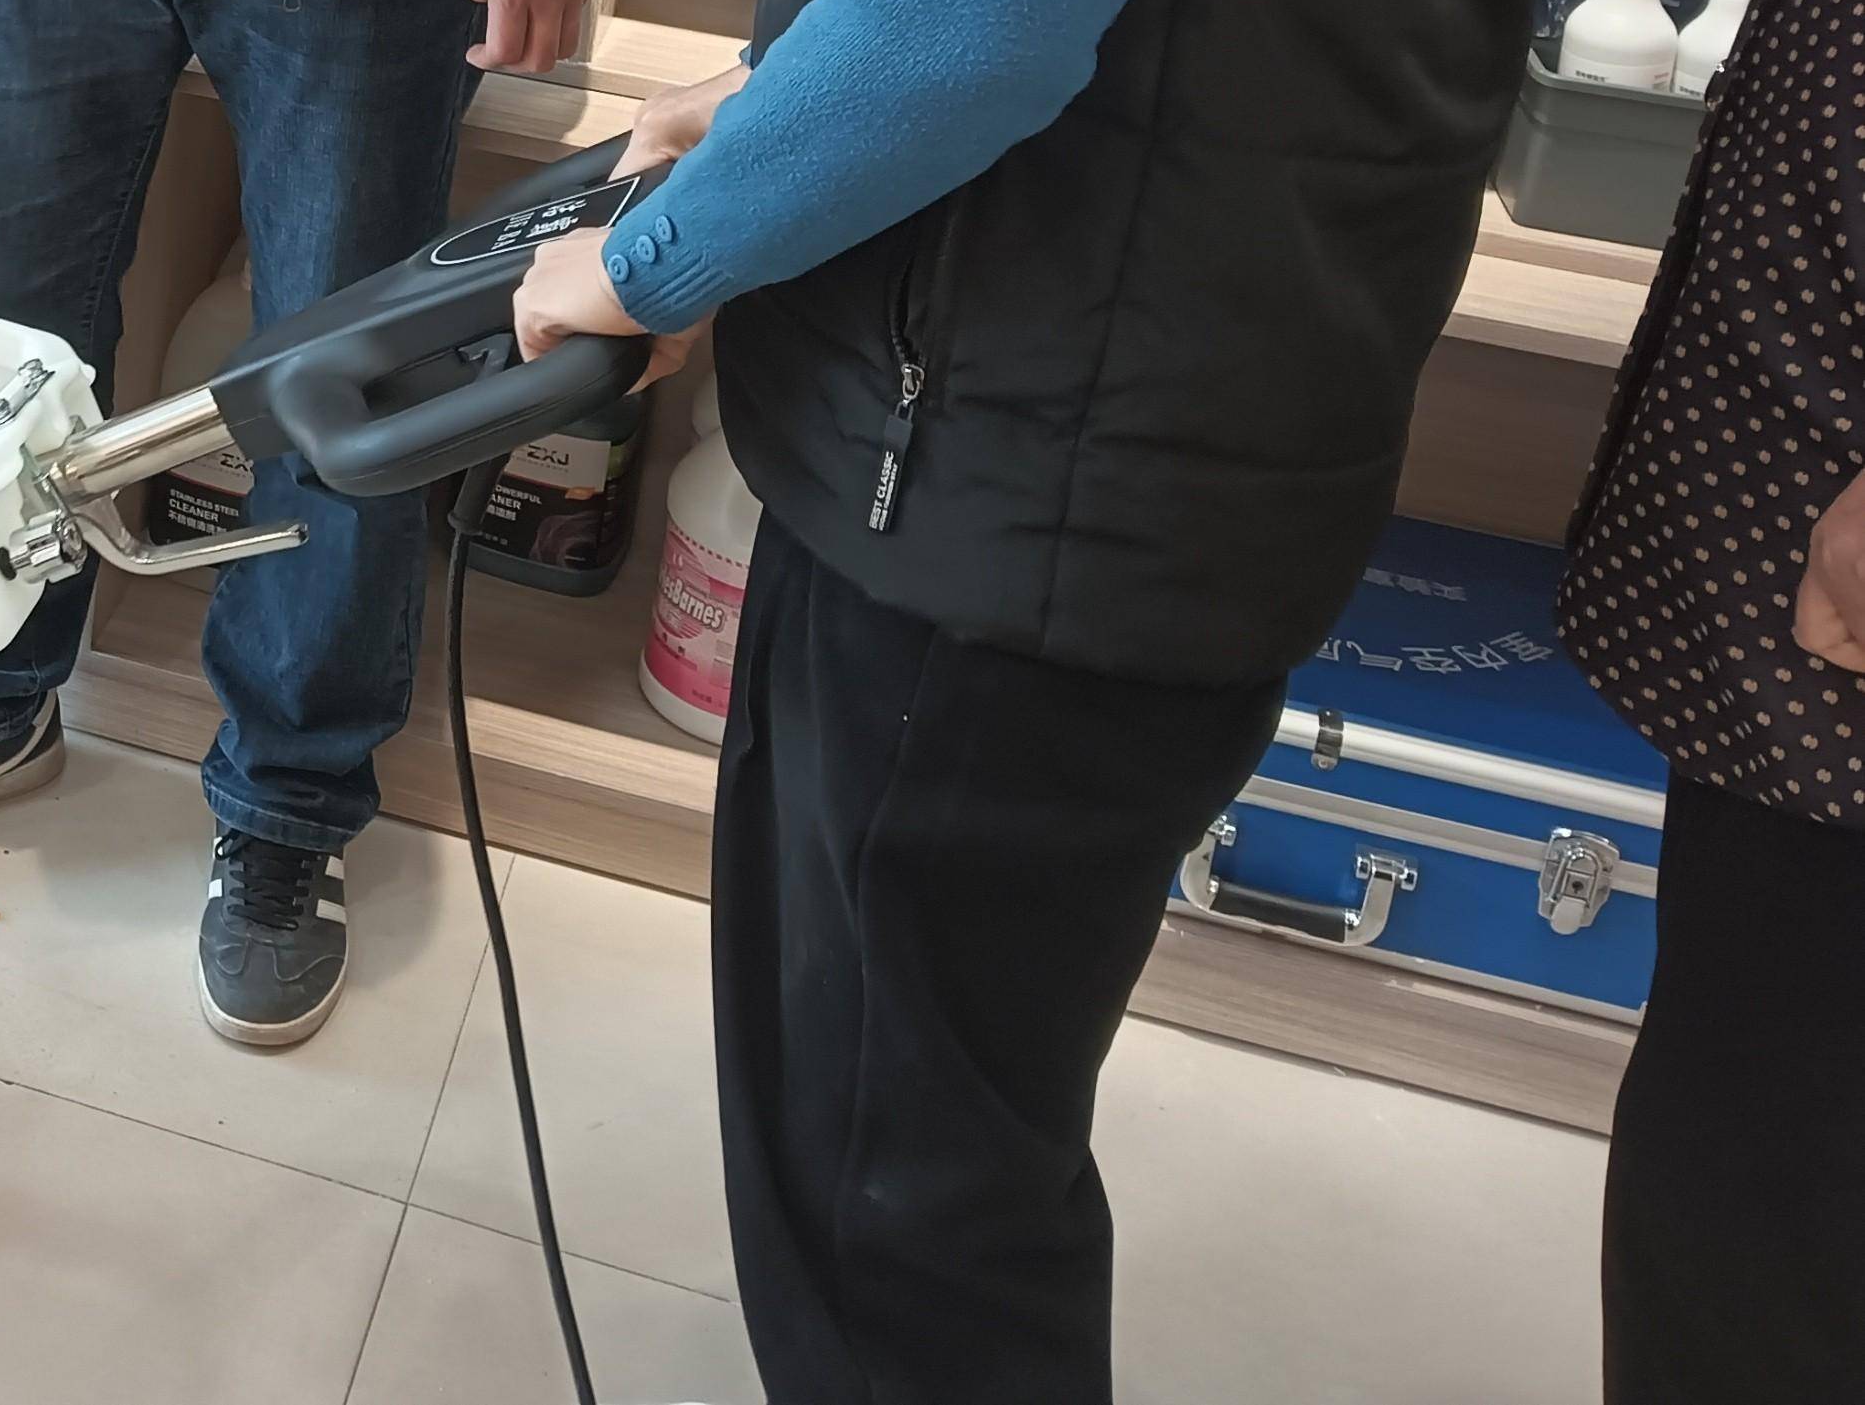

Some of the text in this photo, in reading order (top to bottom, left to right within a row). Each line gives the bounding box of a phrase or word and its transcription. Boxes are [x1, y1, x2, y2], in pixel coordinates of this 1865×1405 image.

[220, 452, 253, 472] ZX
[527, 444, 571, 466] ZXJ
[495, 484, 542, 505] OWERFUL
[868, 498, 883, 530] BEST
[876, 450, 895, 499] CLASSIC
[169, 488, 239, 517] STAINLESS STEEL
[169, 498, 219, 522] CLEANER
[491, 494, 522, 510] ANER
